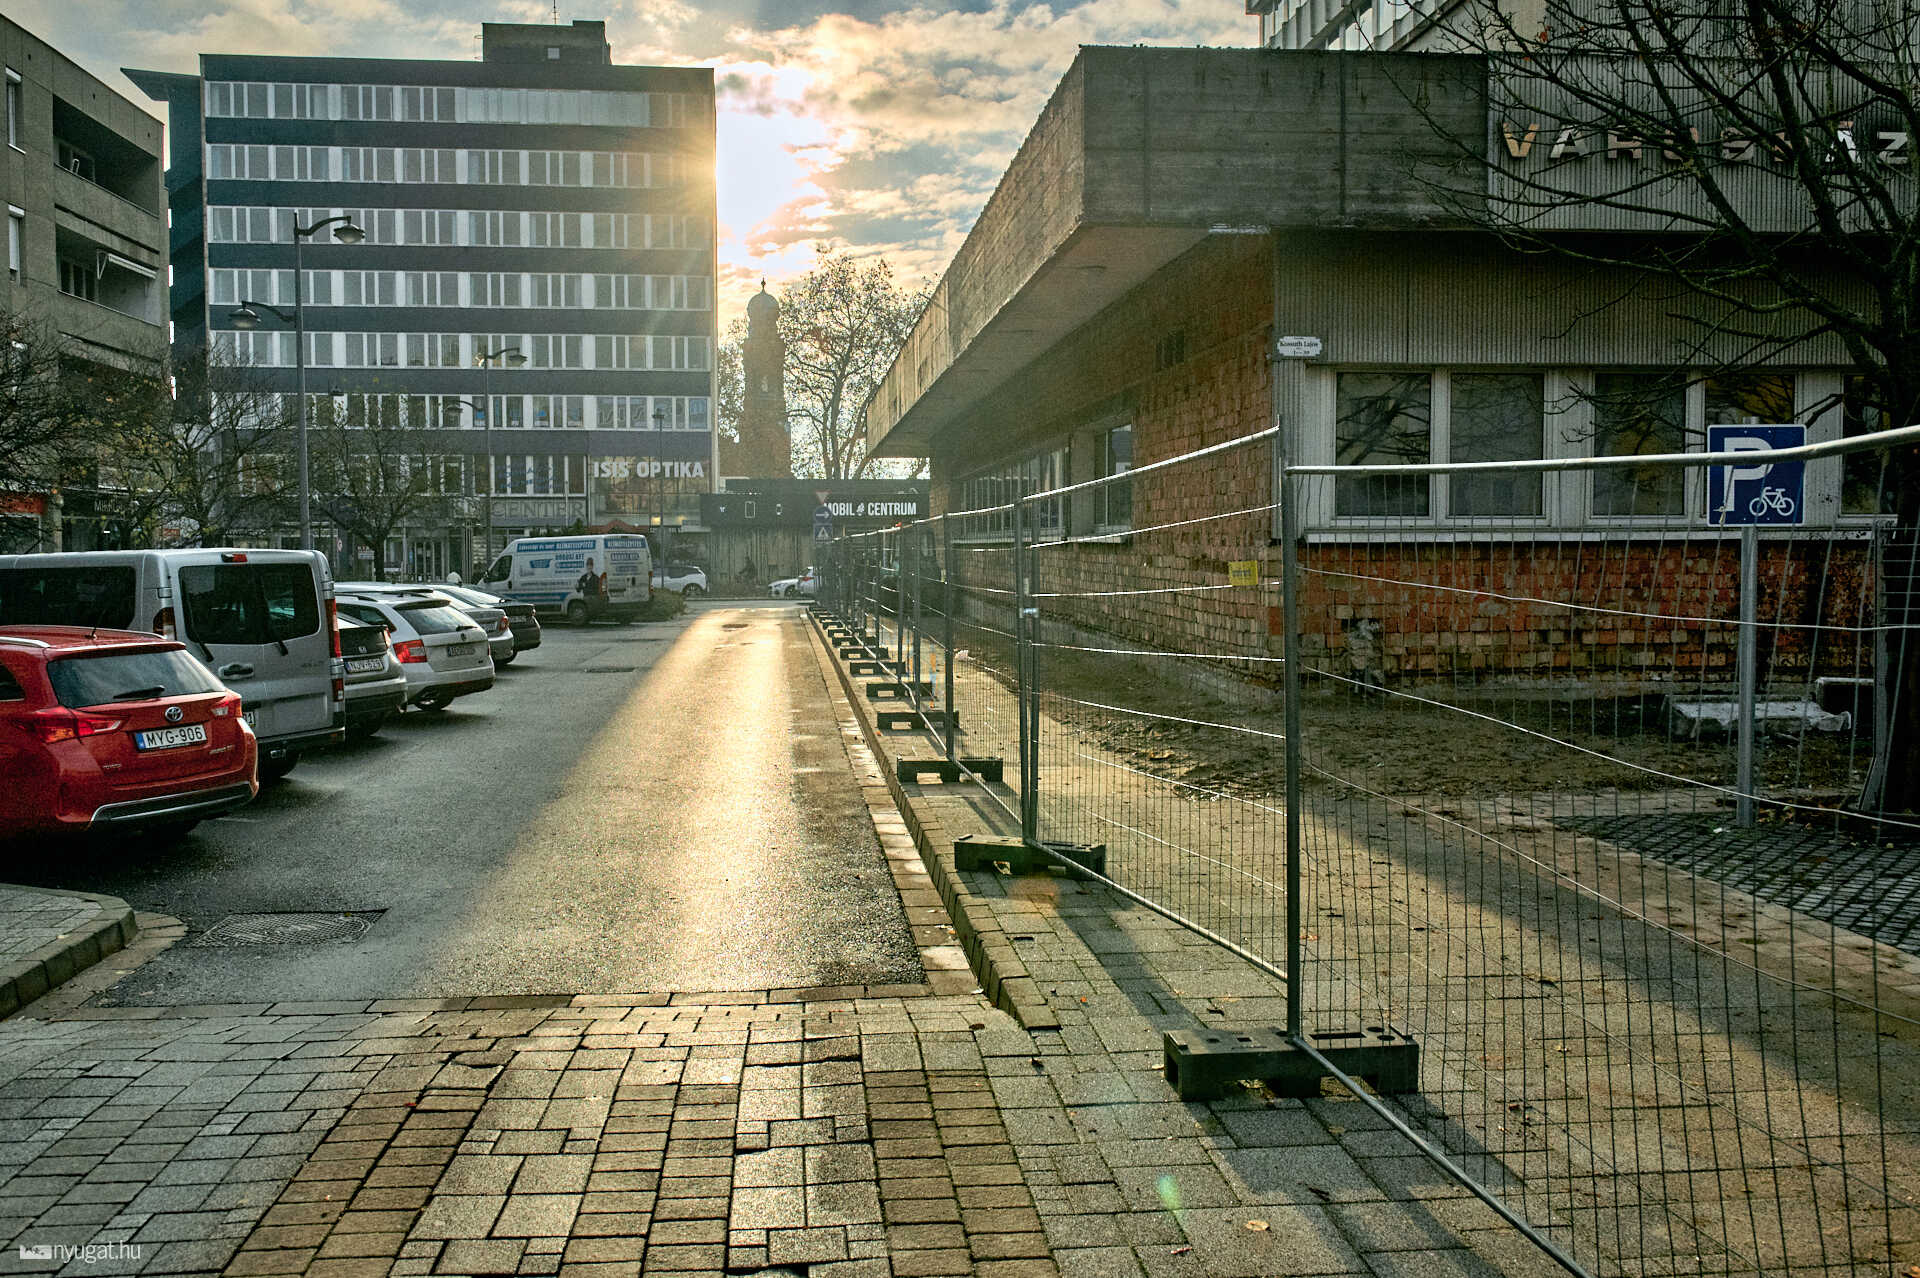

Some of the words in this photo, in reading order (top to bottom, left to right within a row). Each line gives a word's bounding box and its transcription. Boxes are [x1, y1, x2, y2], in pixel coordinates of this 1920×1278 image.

[593, 461, 630, 478] ISIS
[636, 461, 705, 478] OPTIKA
[1723, 436, 1775, 512] P
[491, 500, 586, 518] CENTER
[823, 502, 855, 516] MOBIL
[867, 502, 917, 516] CENTRUM
[146, 726, 204, 747] MYG-906
